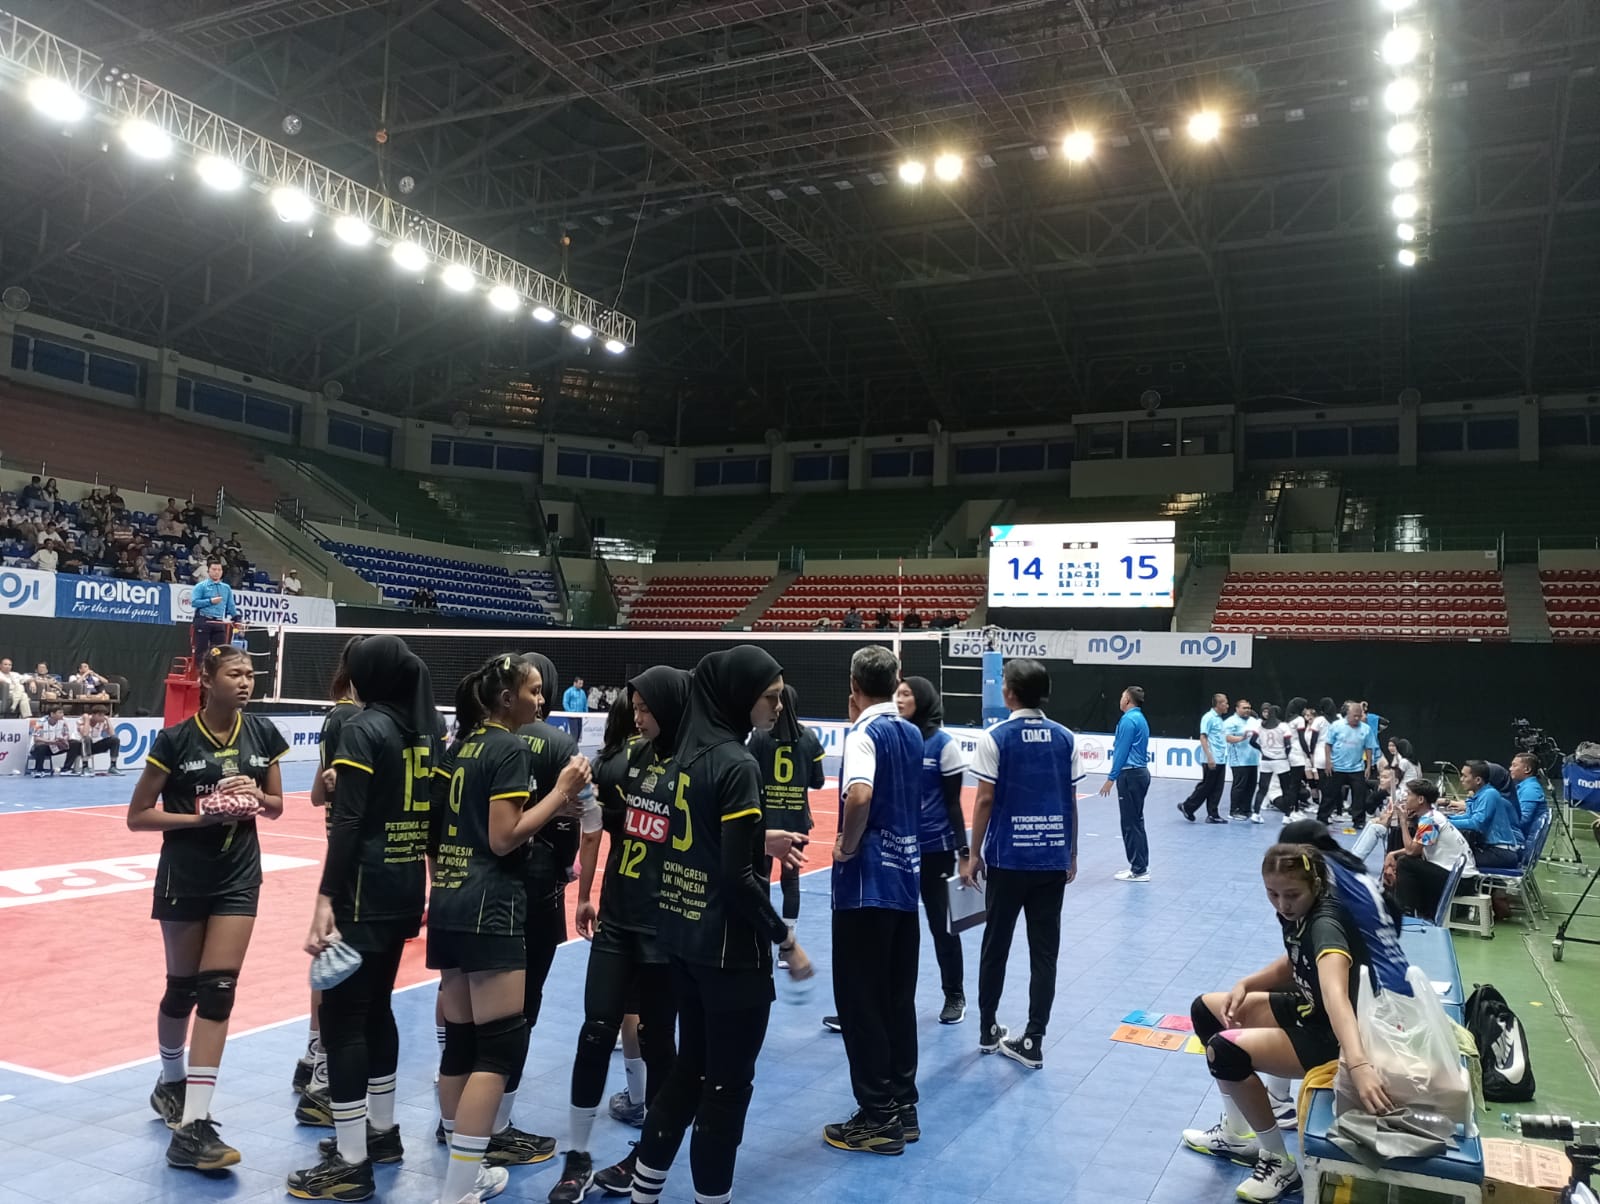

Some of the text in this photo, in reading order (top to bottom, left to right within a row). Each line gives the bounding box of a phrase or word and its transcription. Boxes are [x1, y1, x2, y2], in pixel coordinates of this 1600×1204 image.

[1008, 557, 1043, 580] 14
[1120, 555, 1158, 580] 15
[75, 581, 160, 605] molten
[233, 594, 290, 610] UNJUNG
[72, 601, 159, 619] For the real game
[1021, 728, 1052, 742] COACH
[774, 746, 794, 783] 6
[402, 747, 430, 811] 15
[625, 809, 666, 840] LUS
[672, 771, 694, 852] 5
[221, 820, 238, 853] 7
[618, 839, 647, 879] 12
